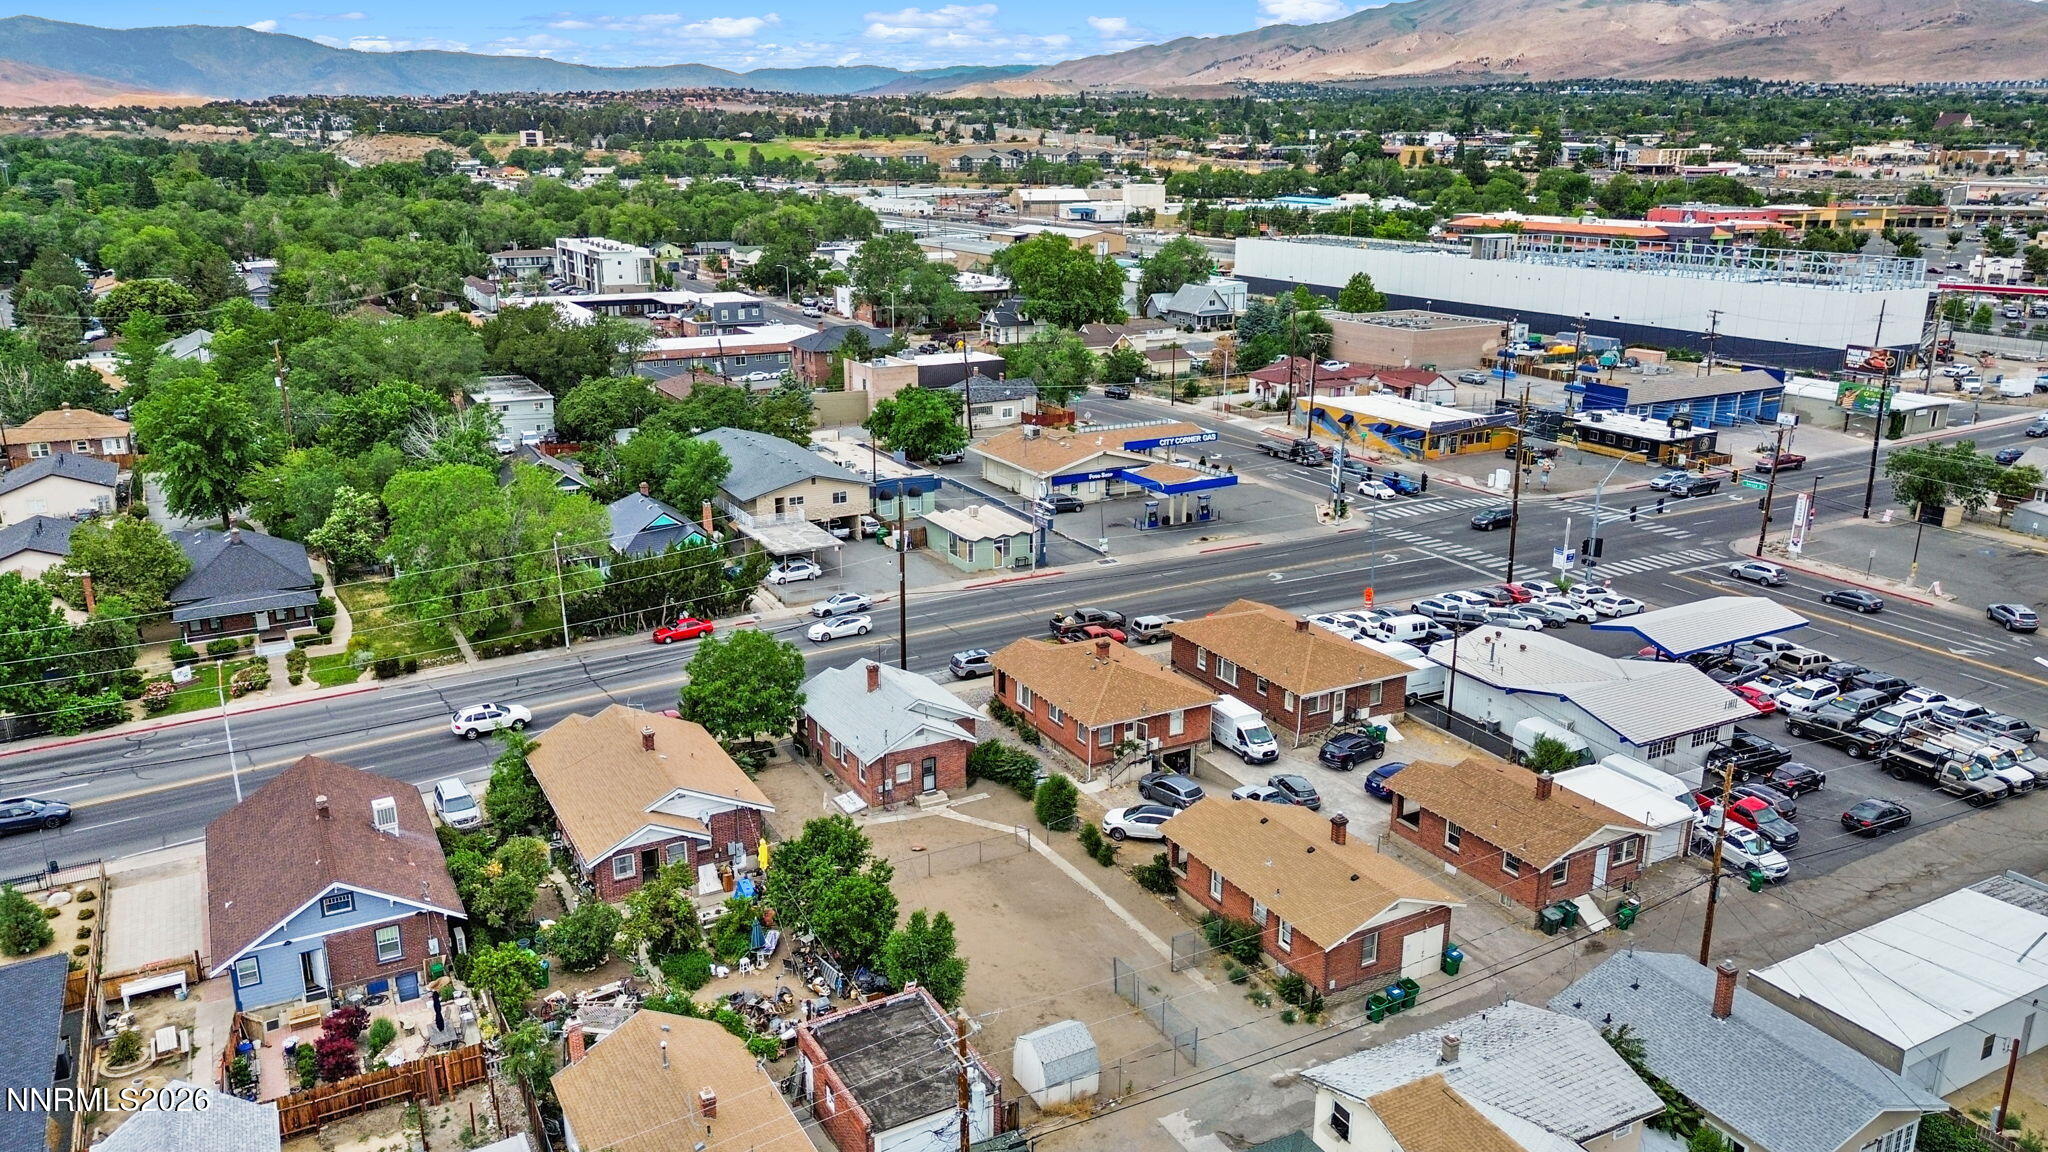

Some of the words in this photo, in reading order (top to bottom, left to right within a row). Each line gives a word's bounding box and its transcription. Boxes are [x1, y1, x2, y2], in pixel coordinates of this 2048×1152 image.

[1159, 438, 1174, 446] CITY
[1175, 435, 1201, 444] CORNER
[1202, 433, 1216, 441] GAS
